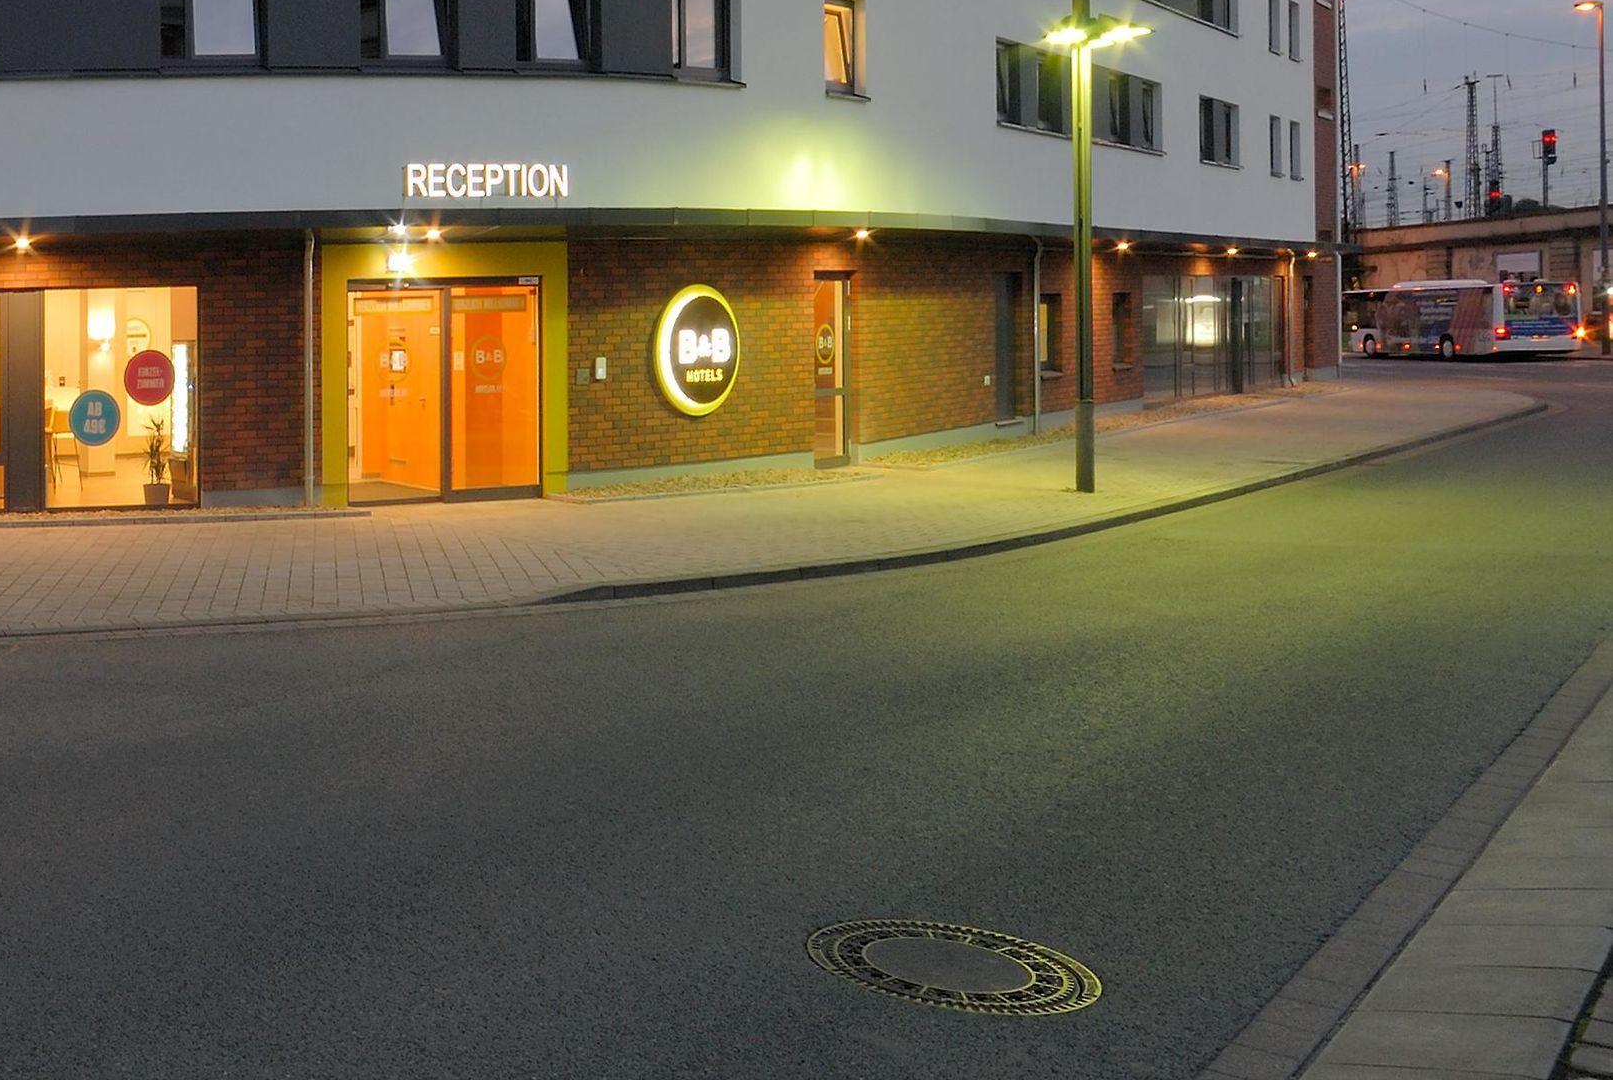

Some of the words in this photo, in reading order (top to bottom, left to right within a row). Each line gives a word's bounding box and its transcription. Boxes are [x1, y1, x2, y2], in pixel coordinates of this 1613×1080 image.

[404, 162, 569, 198] RECEPTION
[678, 327, 731, 364] B&B
[686, 368, 724, 383] HOTELS
[88, 401, 103, 417] AB
